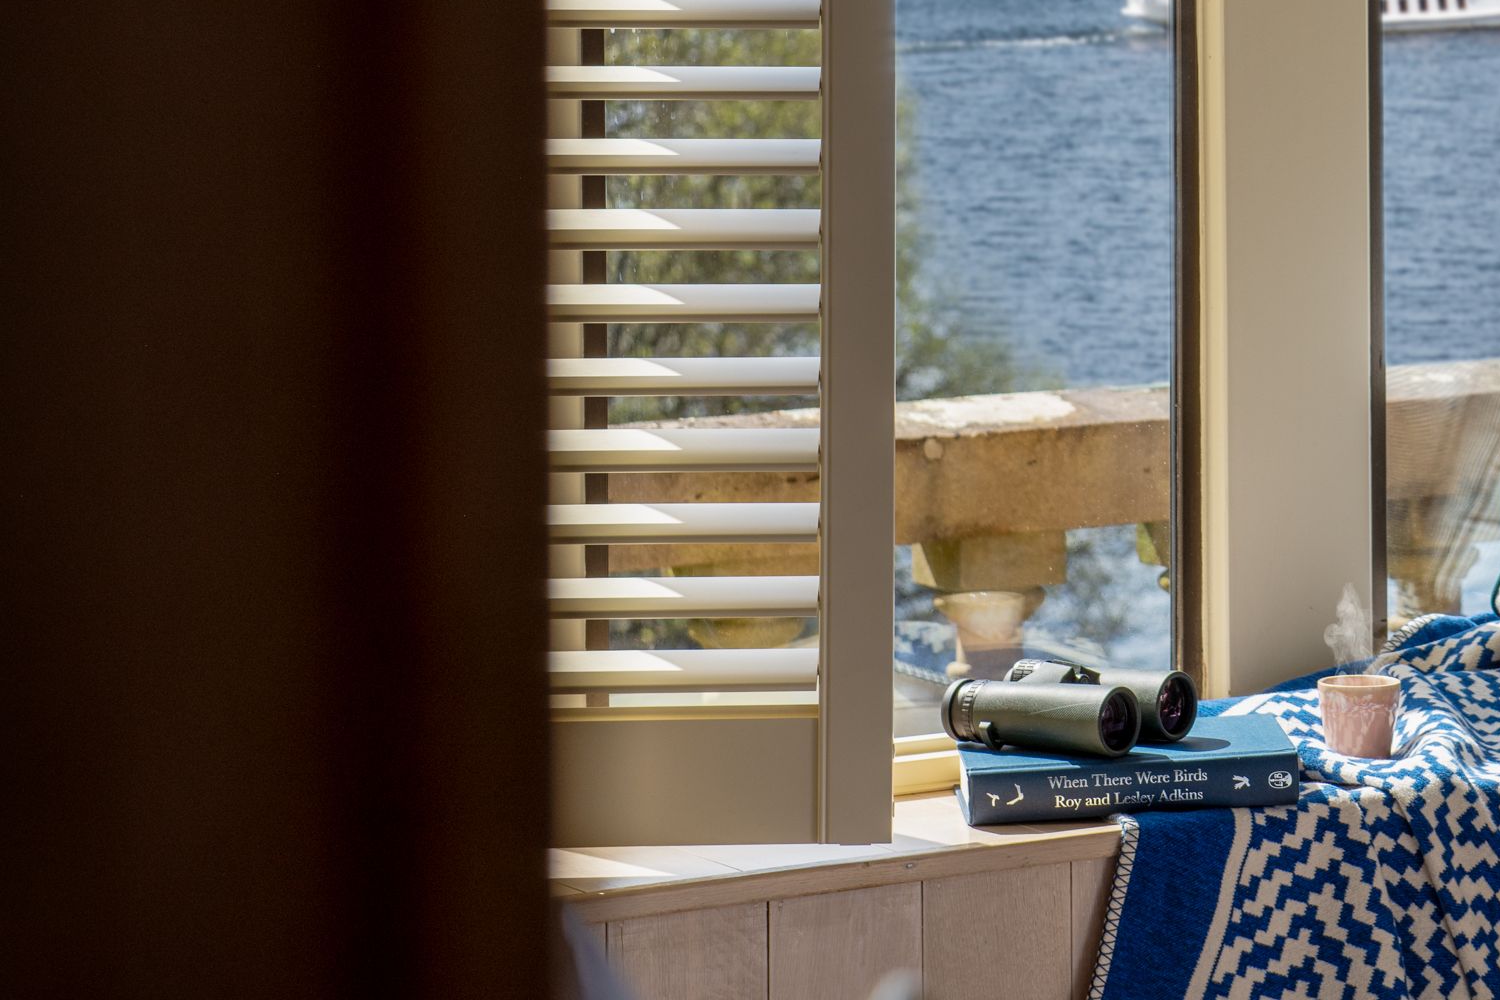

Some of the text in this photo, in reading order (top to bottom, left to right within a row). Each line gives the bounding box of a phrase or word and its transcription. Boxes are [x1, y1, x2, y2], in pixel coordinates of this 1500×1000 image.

[1048, 768, 1208, 789] When There Were Birds
[1055, 788, 1204, 810] Roy and Lesley Adkins
